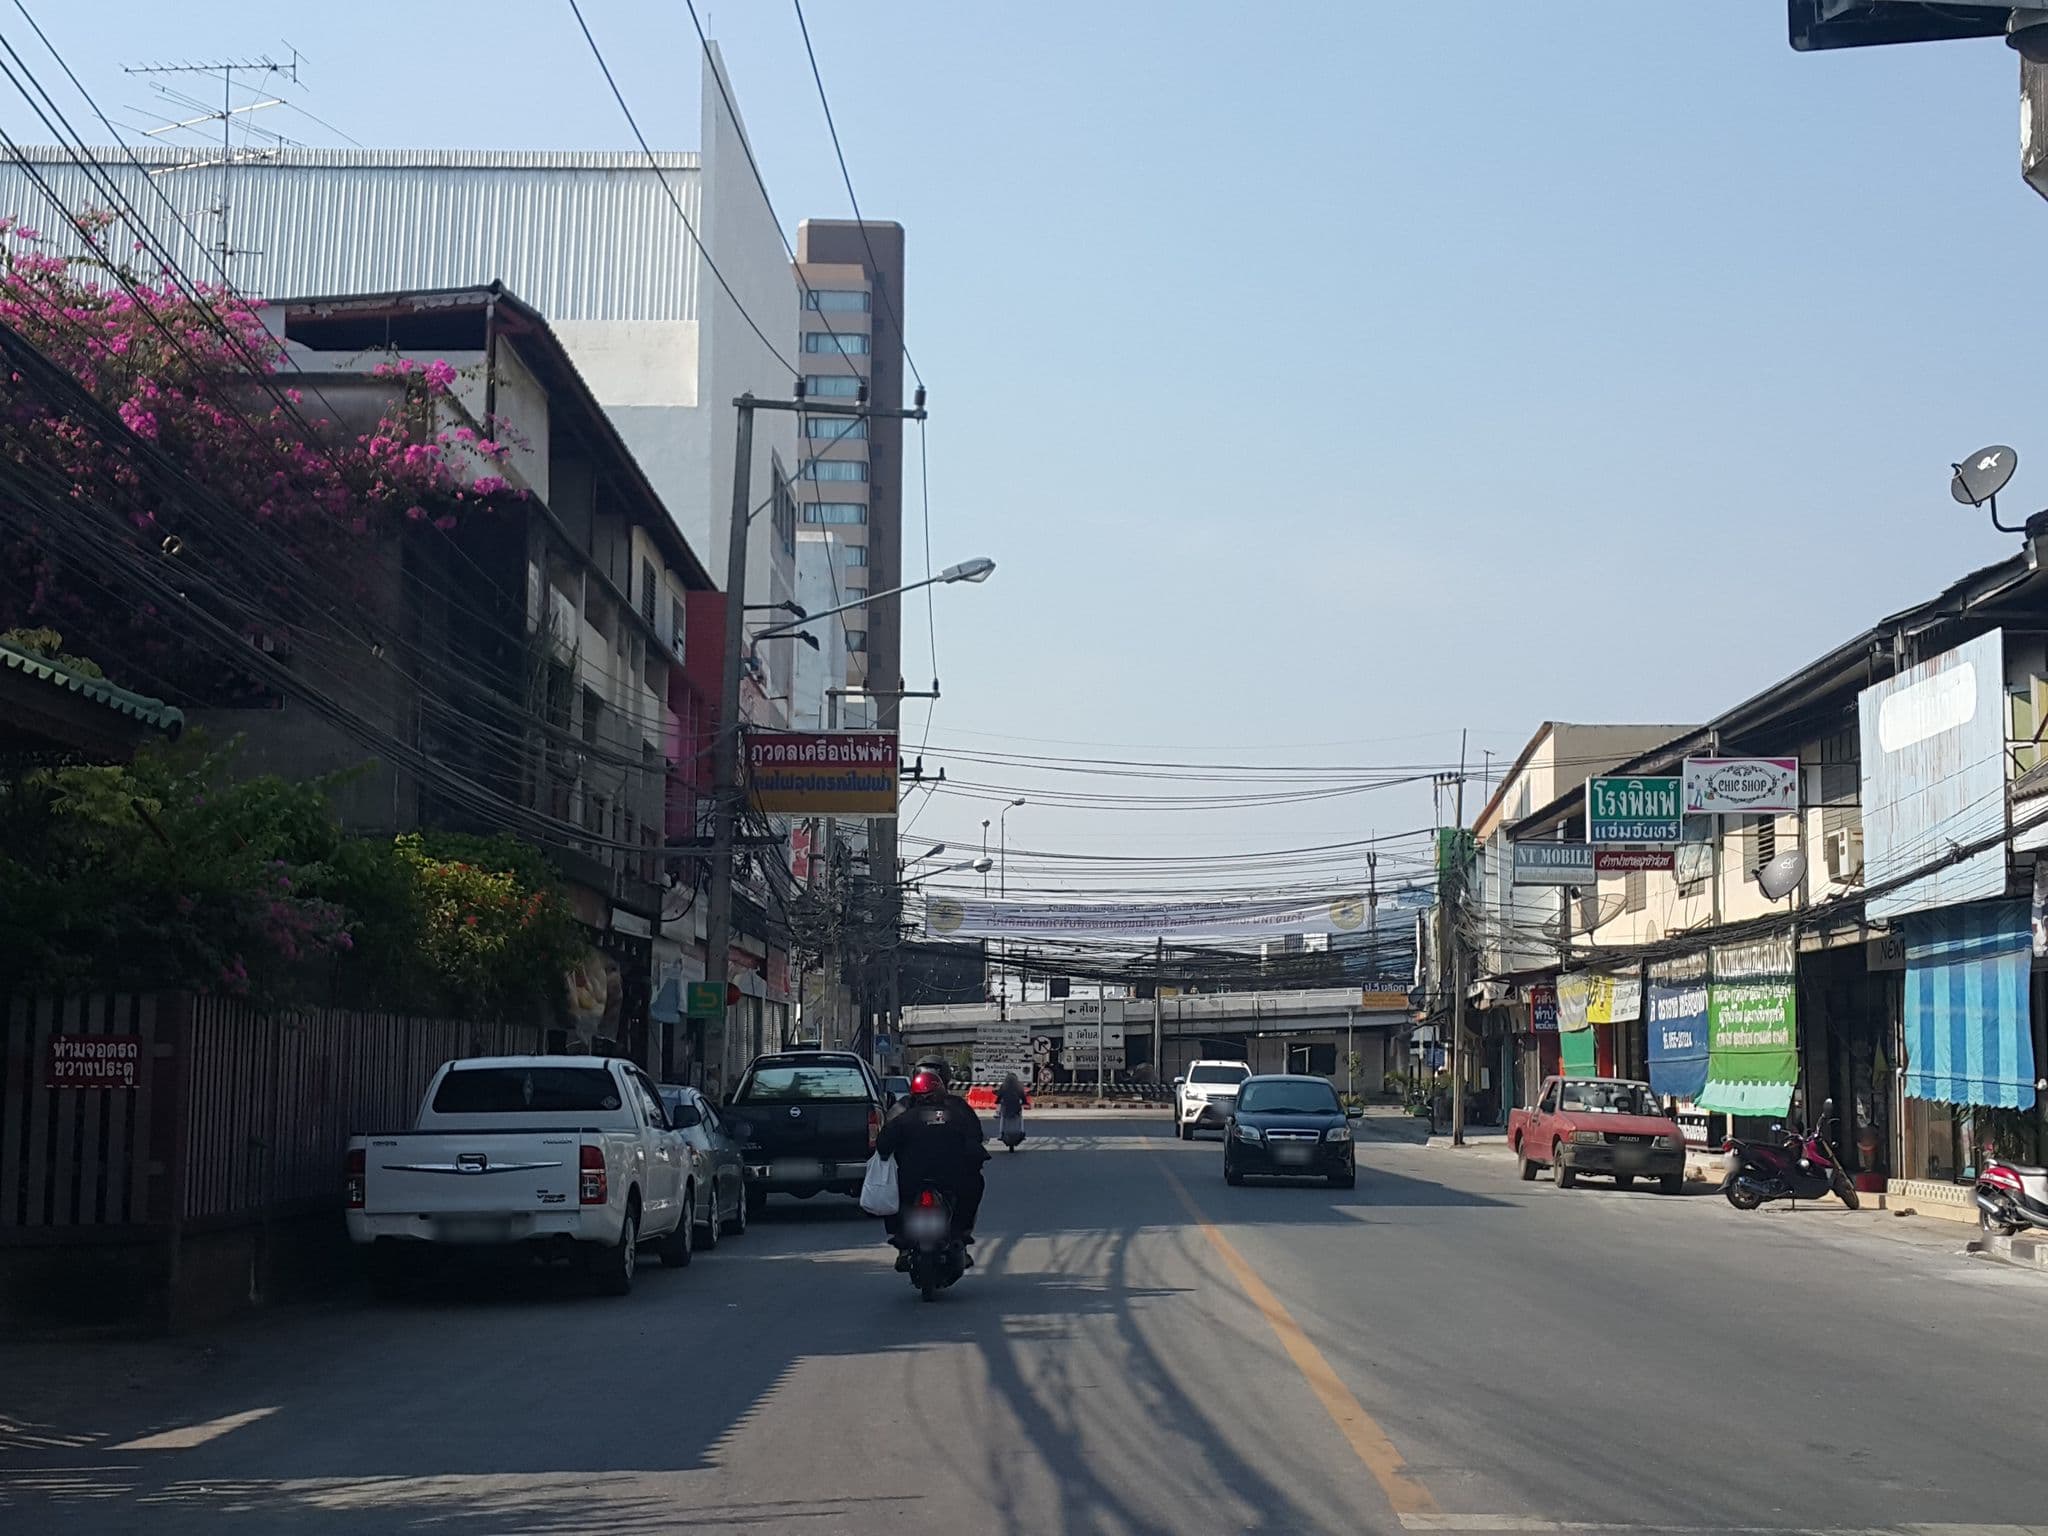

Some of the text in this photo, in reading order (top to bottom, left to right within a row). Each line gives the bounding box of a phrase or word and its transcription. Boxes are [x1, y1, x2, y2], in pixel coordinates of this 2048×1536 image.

[1718, 778, 1768, 793] CHIC SHOP
[1593, 779, 1678, 817] โรงพิมพ์
[1594, 821, 1678, 840] แจ่มจันทร์
[1518, 848, 1593, 866] NT MOBILE
[53, 1036, 138, 1058] ห้ามจอดรถ
[54, 1059, 135, 1085] ขวางประตู
